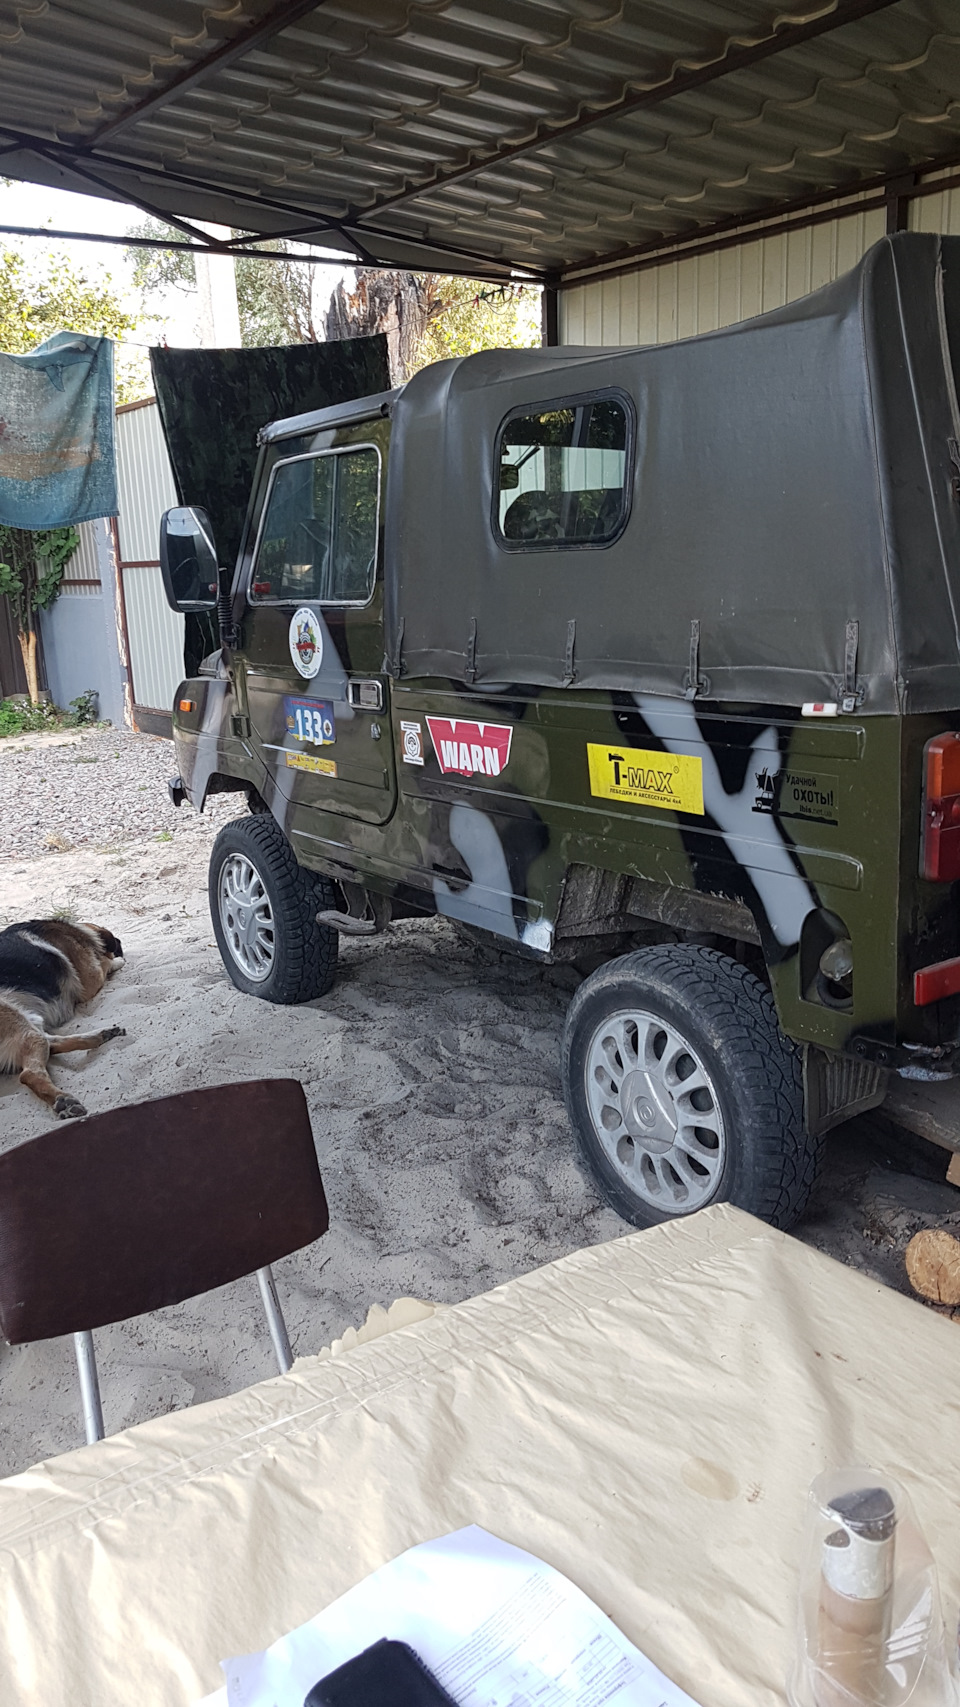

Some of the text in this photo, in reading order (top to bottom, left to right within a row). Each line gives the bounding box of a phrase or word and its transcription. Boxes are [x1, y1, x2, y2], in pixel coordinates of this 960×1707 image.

[295, 709, 323, 746] 133
[440, 740, 500, 777] WARN
[608, 753, 674, 794] T-MAX
[786, 773, 817, 787] Удачной
